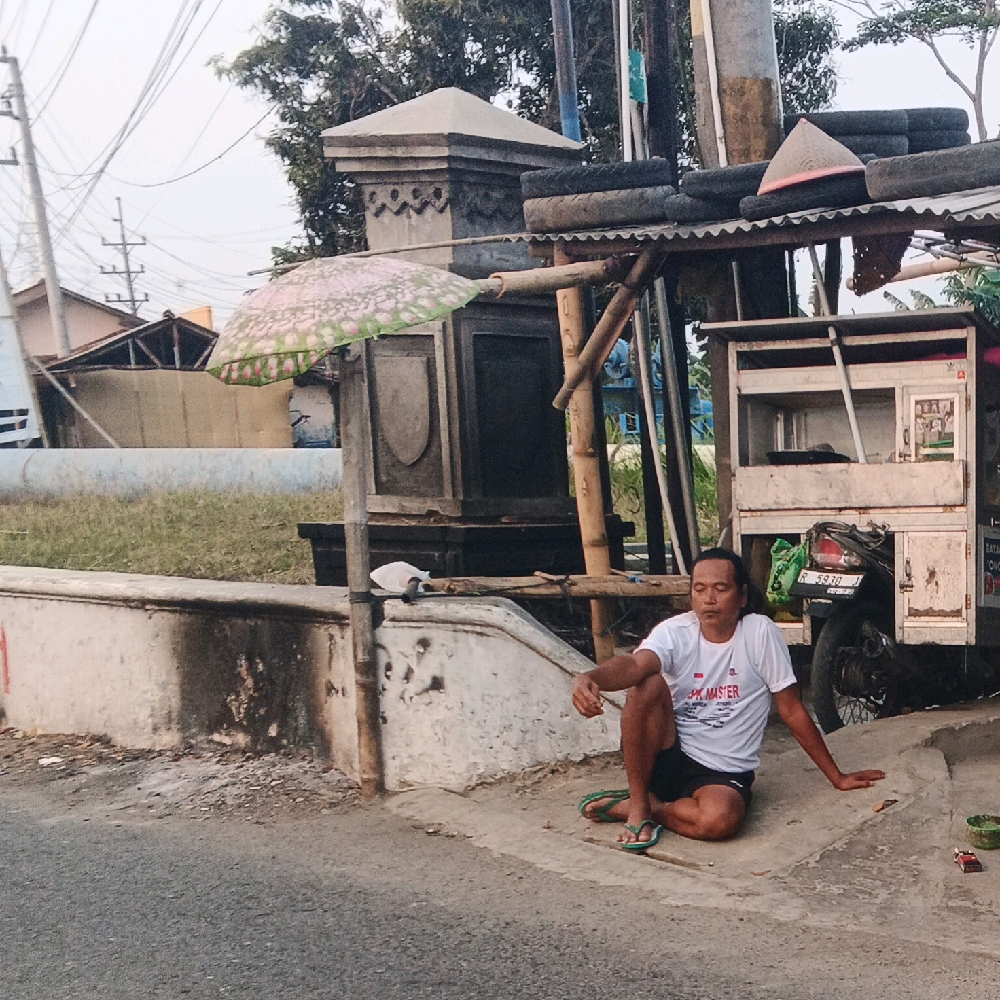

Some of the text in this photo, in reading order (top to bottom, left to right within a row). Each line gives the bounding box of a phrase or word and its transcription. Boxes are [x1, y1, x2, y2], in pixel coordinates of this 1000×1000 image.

[800, 572, 808, 582] R
[815, 574, 842, 586] 5930
[704, 684, 741, 701] MASTER
